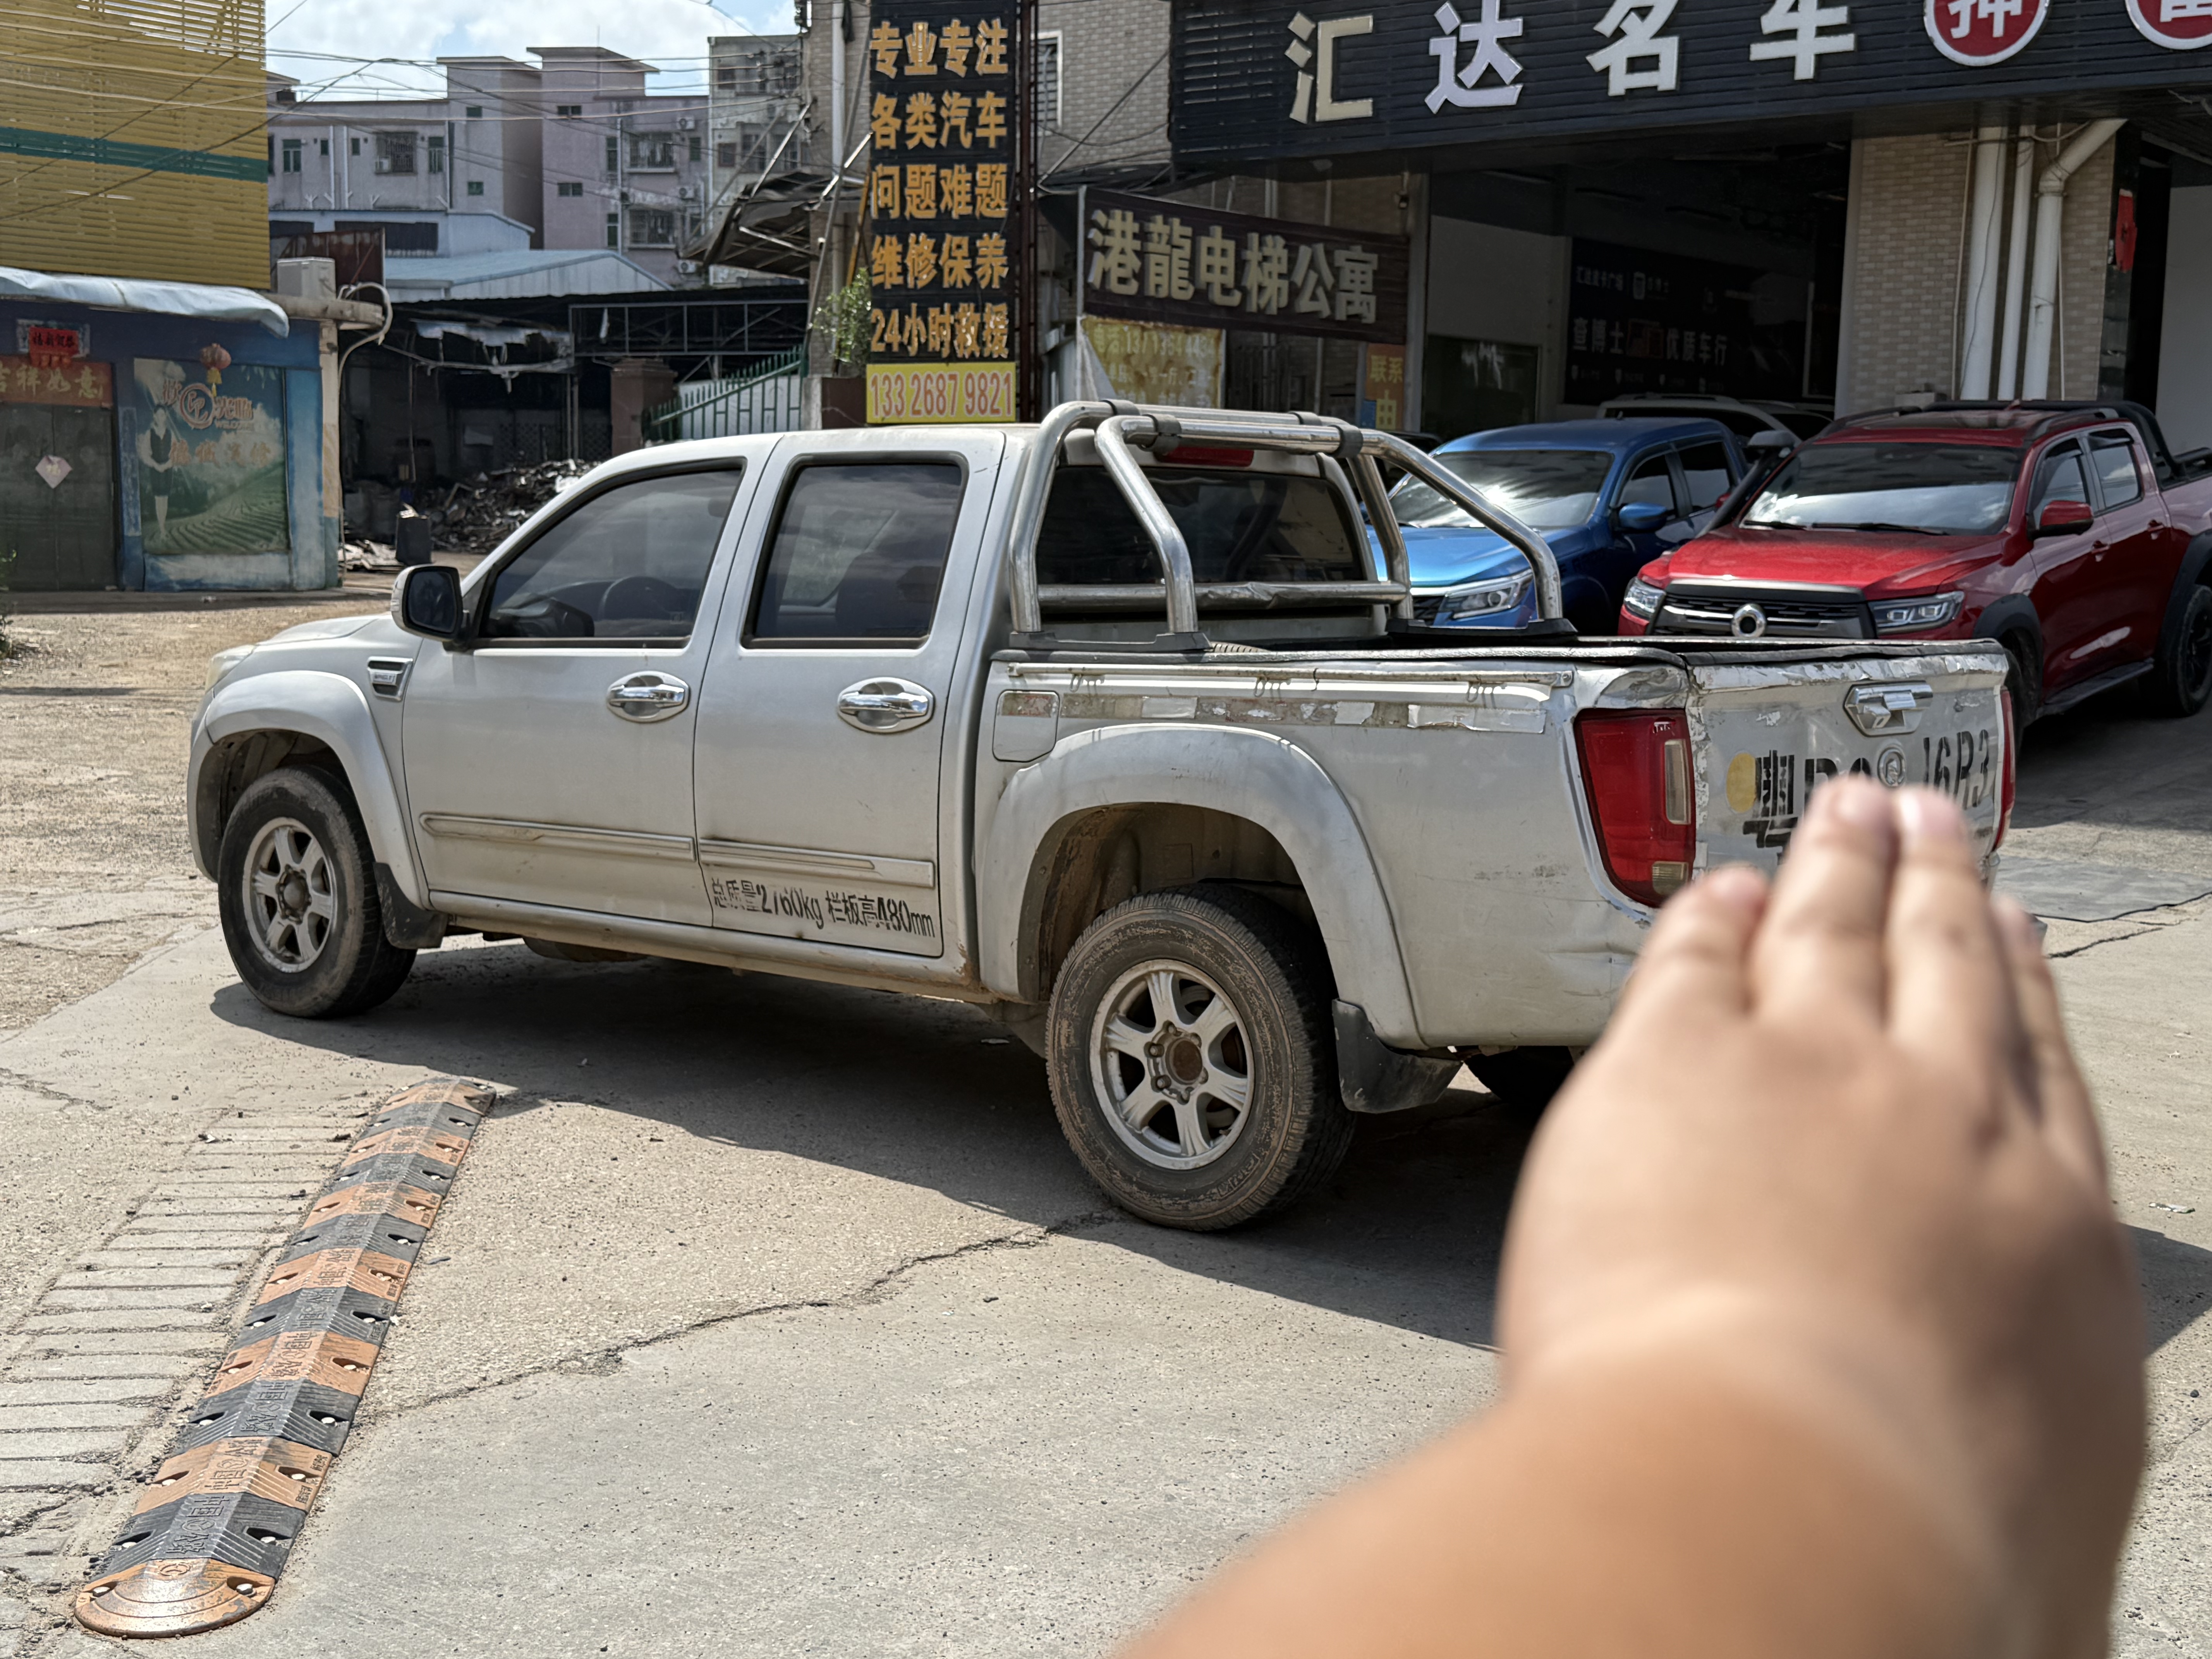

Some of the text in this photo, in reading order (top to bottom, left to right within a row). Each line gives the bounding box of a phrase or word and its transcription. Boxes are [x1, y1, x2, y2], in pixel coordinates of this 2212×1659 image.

[869, 18, 1008, 79] 专业专注
[1285, 0, 1856, 125] 汇达名车
[871, 90, 1007, 149] 各类汽车
[871, 163, 1008, 220] 问题难题
[871, 233, 1008, 289] 维修保养
[1087, 209, 1379, 324] 港龍电梯公寓
[871, 302, 1009, 359] 24小时救援
[871, 371, 1013, 417] 133 2687 9821
